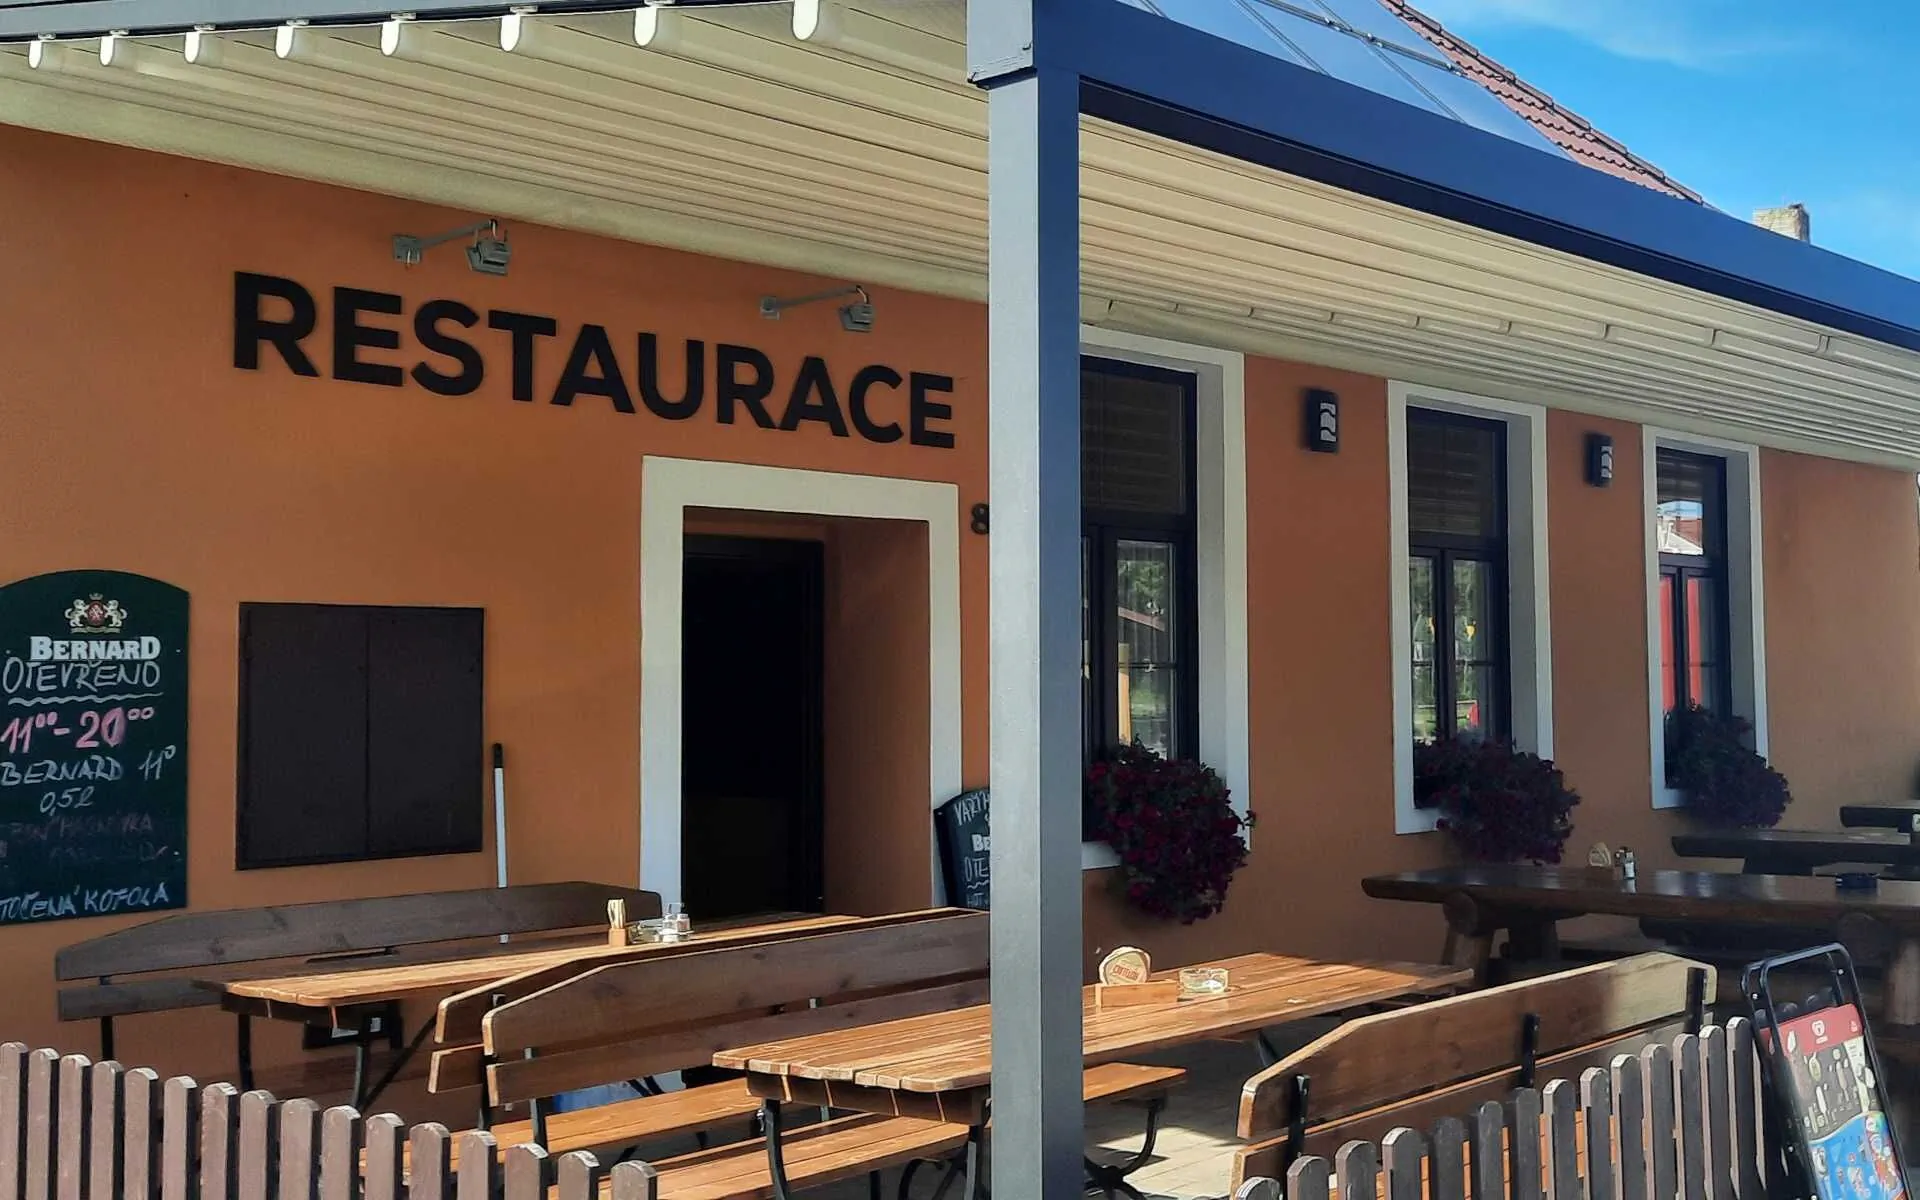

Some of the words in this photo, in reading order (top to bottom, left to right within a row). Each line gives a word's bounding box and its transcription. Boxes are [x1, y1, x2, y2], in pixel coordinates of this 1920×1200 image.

[233, 270, 955, 449] RESTAURACE
[30, 635, 161, 660] BERNARD
[0, 754, 123, 787] BERNARD
[84, 881, 170, 913] KOFOLA
